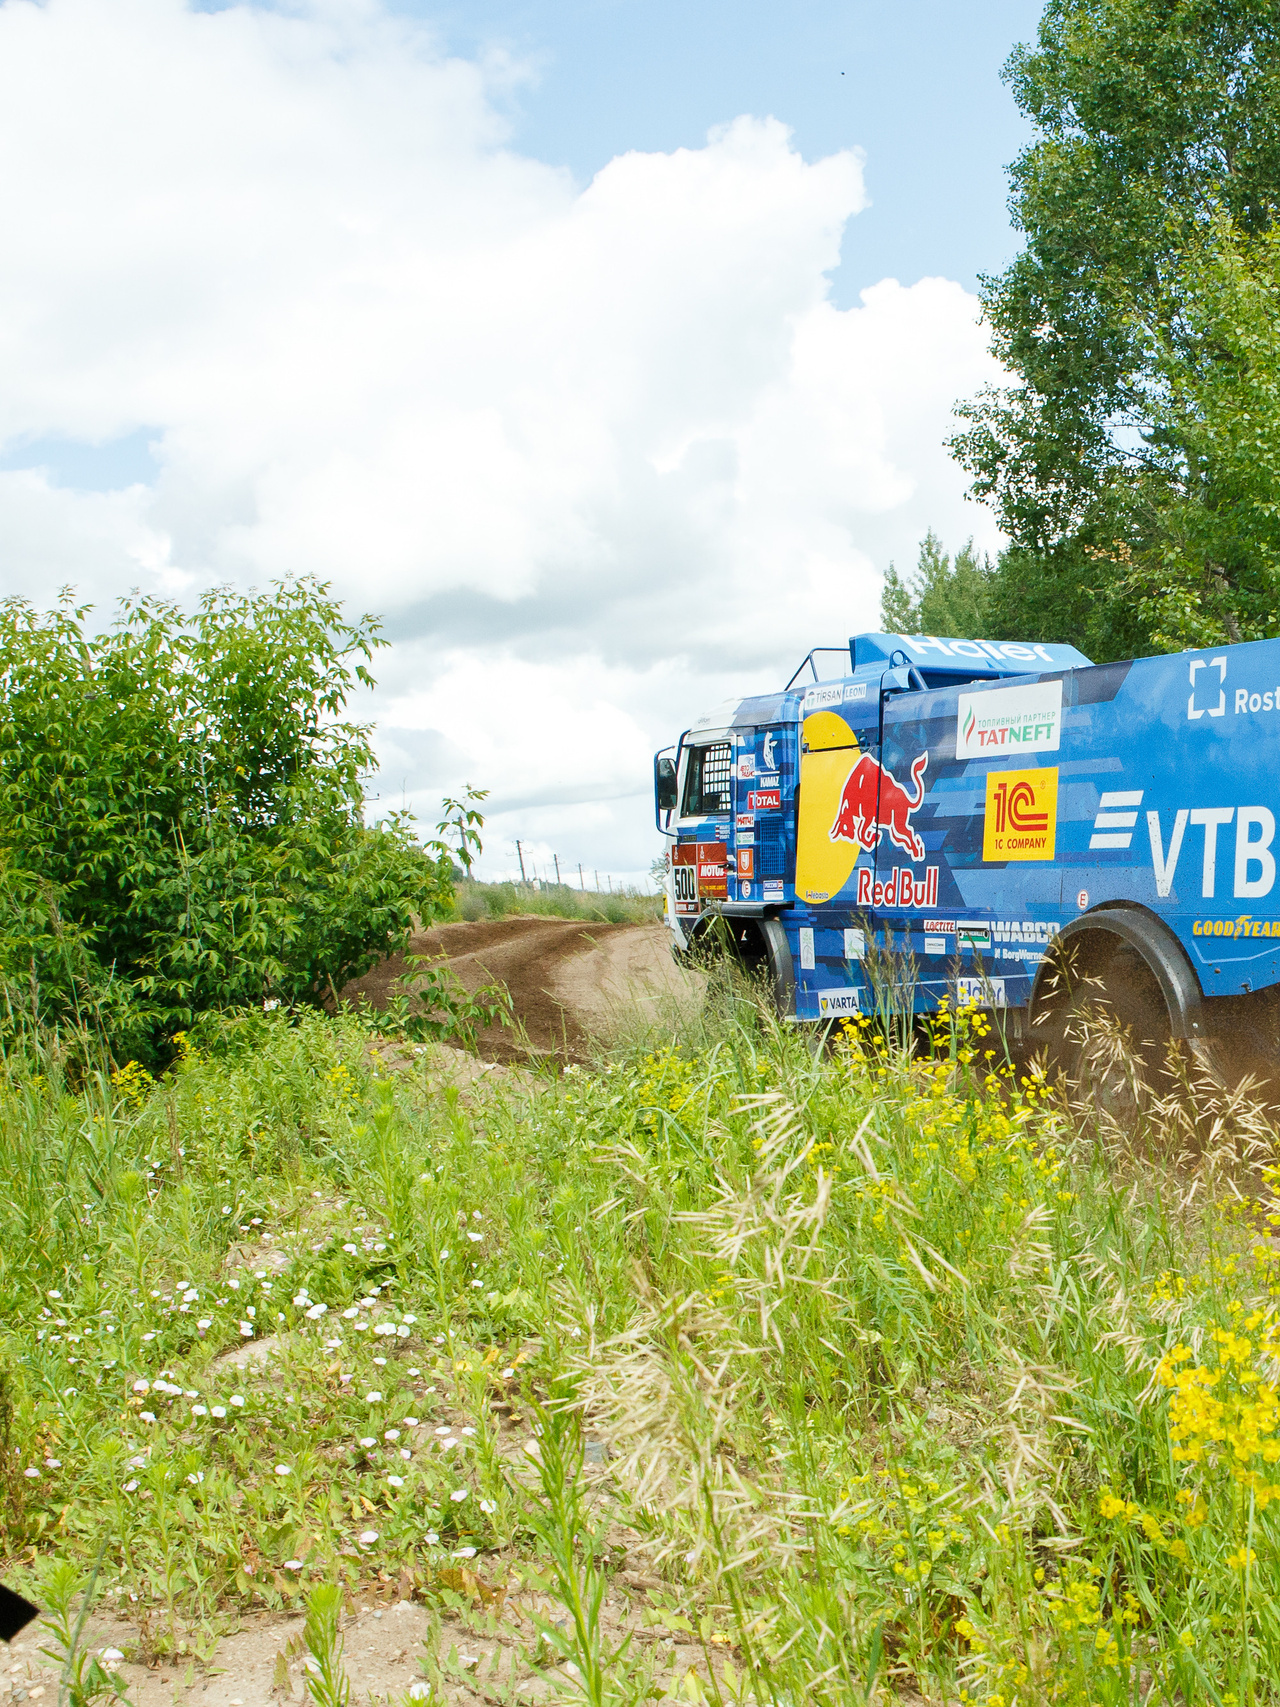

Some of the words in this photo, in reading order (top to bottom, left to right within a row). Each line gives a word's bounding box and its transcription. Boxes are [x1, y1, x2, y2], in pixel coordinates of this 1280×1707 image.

[898, 634, 1054, 662] Haier
[846, 686, 865, 697] LEONI
[978, 714, 1022, 728] ТОПЛИВНЫЙ
[1023, 711, 1056, 724] ПАРТНЕР
[977, 722, 1055, 746] TATNEFT
[760, 776, 779, 788] KAMAZ
[1007, 837, 1047, 850] COMPANY
[1147, 806, 1276, 898] VTB
[674, 867, 696, 901] 500
[856, 867, 898, 905] Red
[899, 866, 939, 907] Bull
[925, 921, 955, 932] LOCTITE
[829, 997, 857, 1010] VARTA
